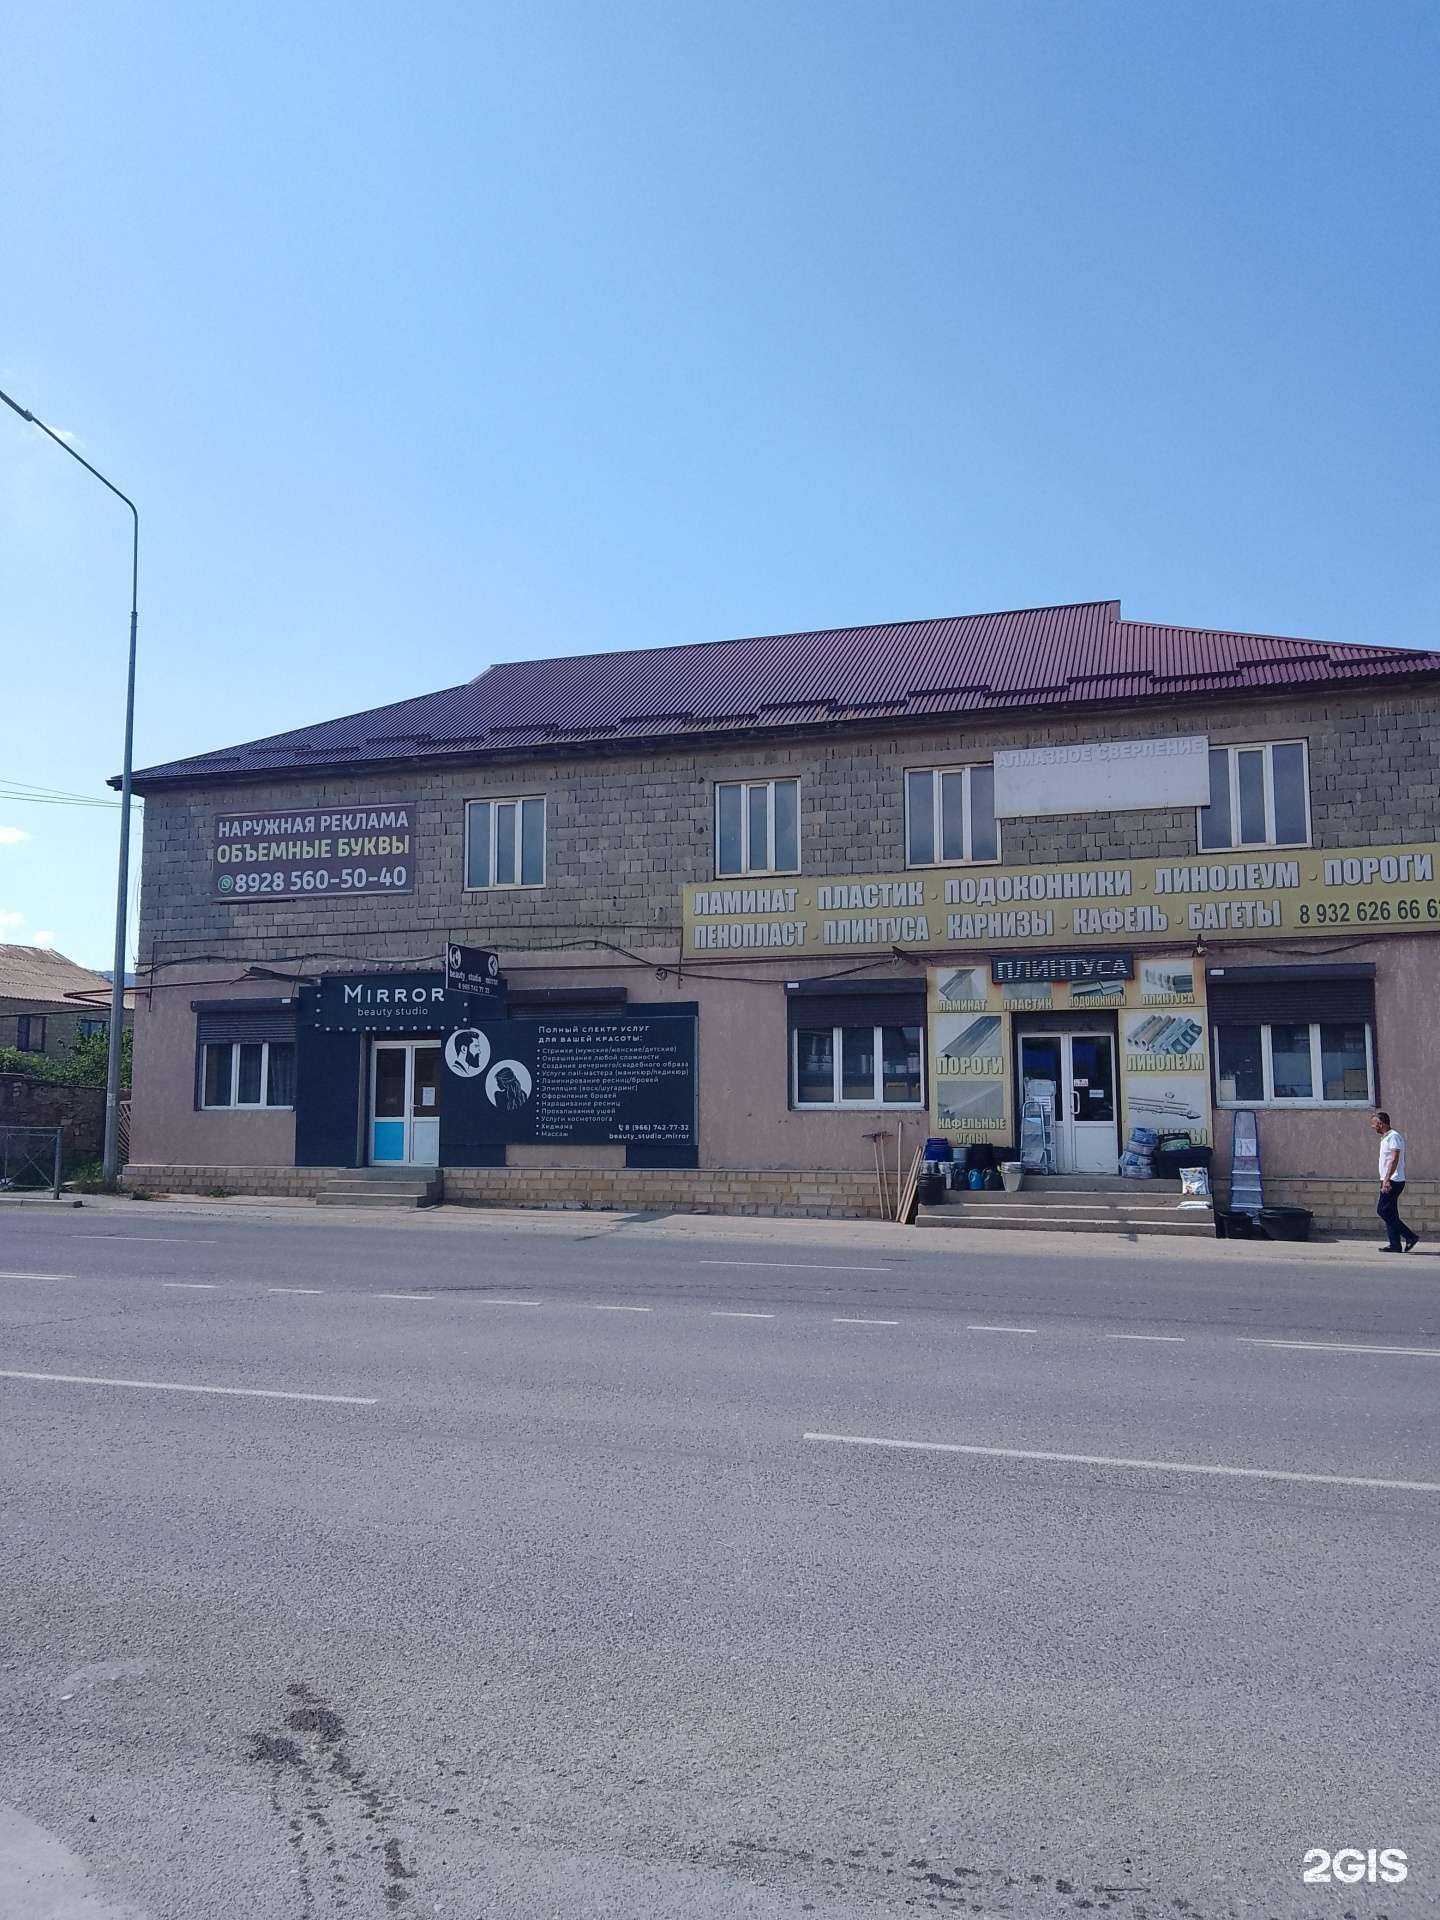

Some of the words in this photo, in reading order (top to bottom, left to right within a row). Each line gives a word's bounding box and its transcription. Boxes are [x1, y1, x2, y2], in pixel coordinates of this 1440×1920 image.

[218, 816, 315, 838] НАРУЖНАЯ
[320, 811, 409, 832] РЕКЛАМА
[217, 839, 332, 864] ОБЪЕМНЫЕ
[338, 835, 410, 857] БУКВЫ
[234, 872, 285, 893] 8928
[290, 866, 407, 890] 560-50-40
[694, 888, 798, 916] ЛАМИНАТ
[817, 881, 924, 910] ПЛАСТИК
[944, 869, 1132, 906] ПОДОКОННИКИ
[1153, 861, 1300, 894] ЛИНОЛЕУМ
[1324, 854, 1434, 886] ПОРОГИ
[1299, 904, 1310, 924] 8
[1316, 902, 1350, 923] 932
[1356, 901, 1391, 921] 626
[1397, 900, 1421, 919] 66
[1427, 898, 1440, 918] 6
[694, 921, 807, 949] ПЕНОПЛАСТ
[823, 915, 930, 945] ПЛИНТУСА
[947, 910, 1054, 940] КАРНИЗЫ
[1073, 905, 1169, 935] КАФЕЛЬ
[1187, 900, 1282, 930] БАГЕТЫ
[997, 959, 1128, 979] ПЛИНТУСА
[939, 999, 987, 1012] ЛАМИНАТ
[1003, 997, 1053, 1011] ПЛАСТИК
[1068, 993, 1127, 1009] ПОДОКОННИКИ
[1142, 991, 1196, 1006] ПЛИНТУСА
[357, 1007, 392, 1017] beauty
[395, 1006, 429, 1016] studio
[936, 1055, 1004, 1076] ПОРОГИ
[1127, 1053, 1205, 1072] ЛИНОЛЕУМ
[938, 1116, 1007, 1130] КАФЕЛЬНЫЕ
